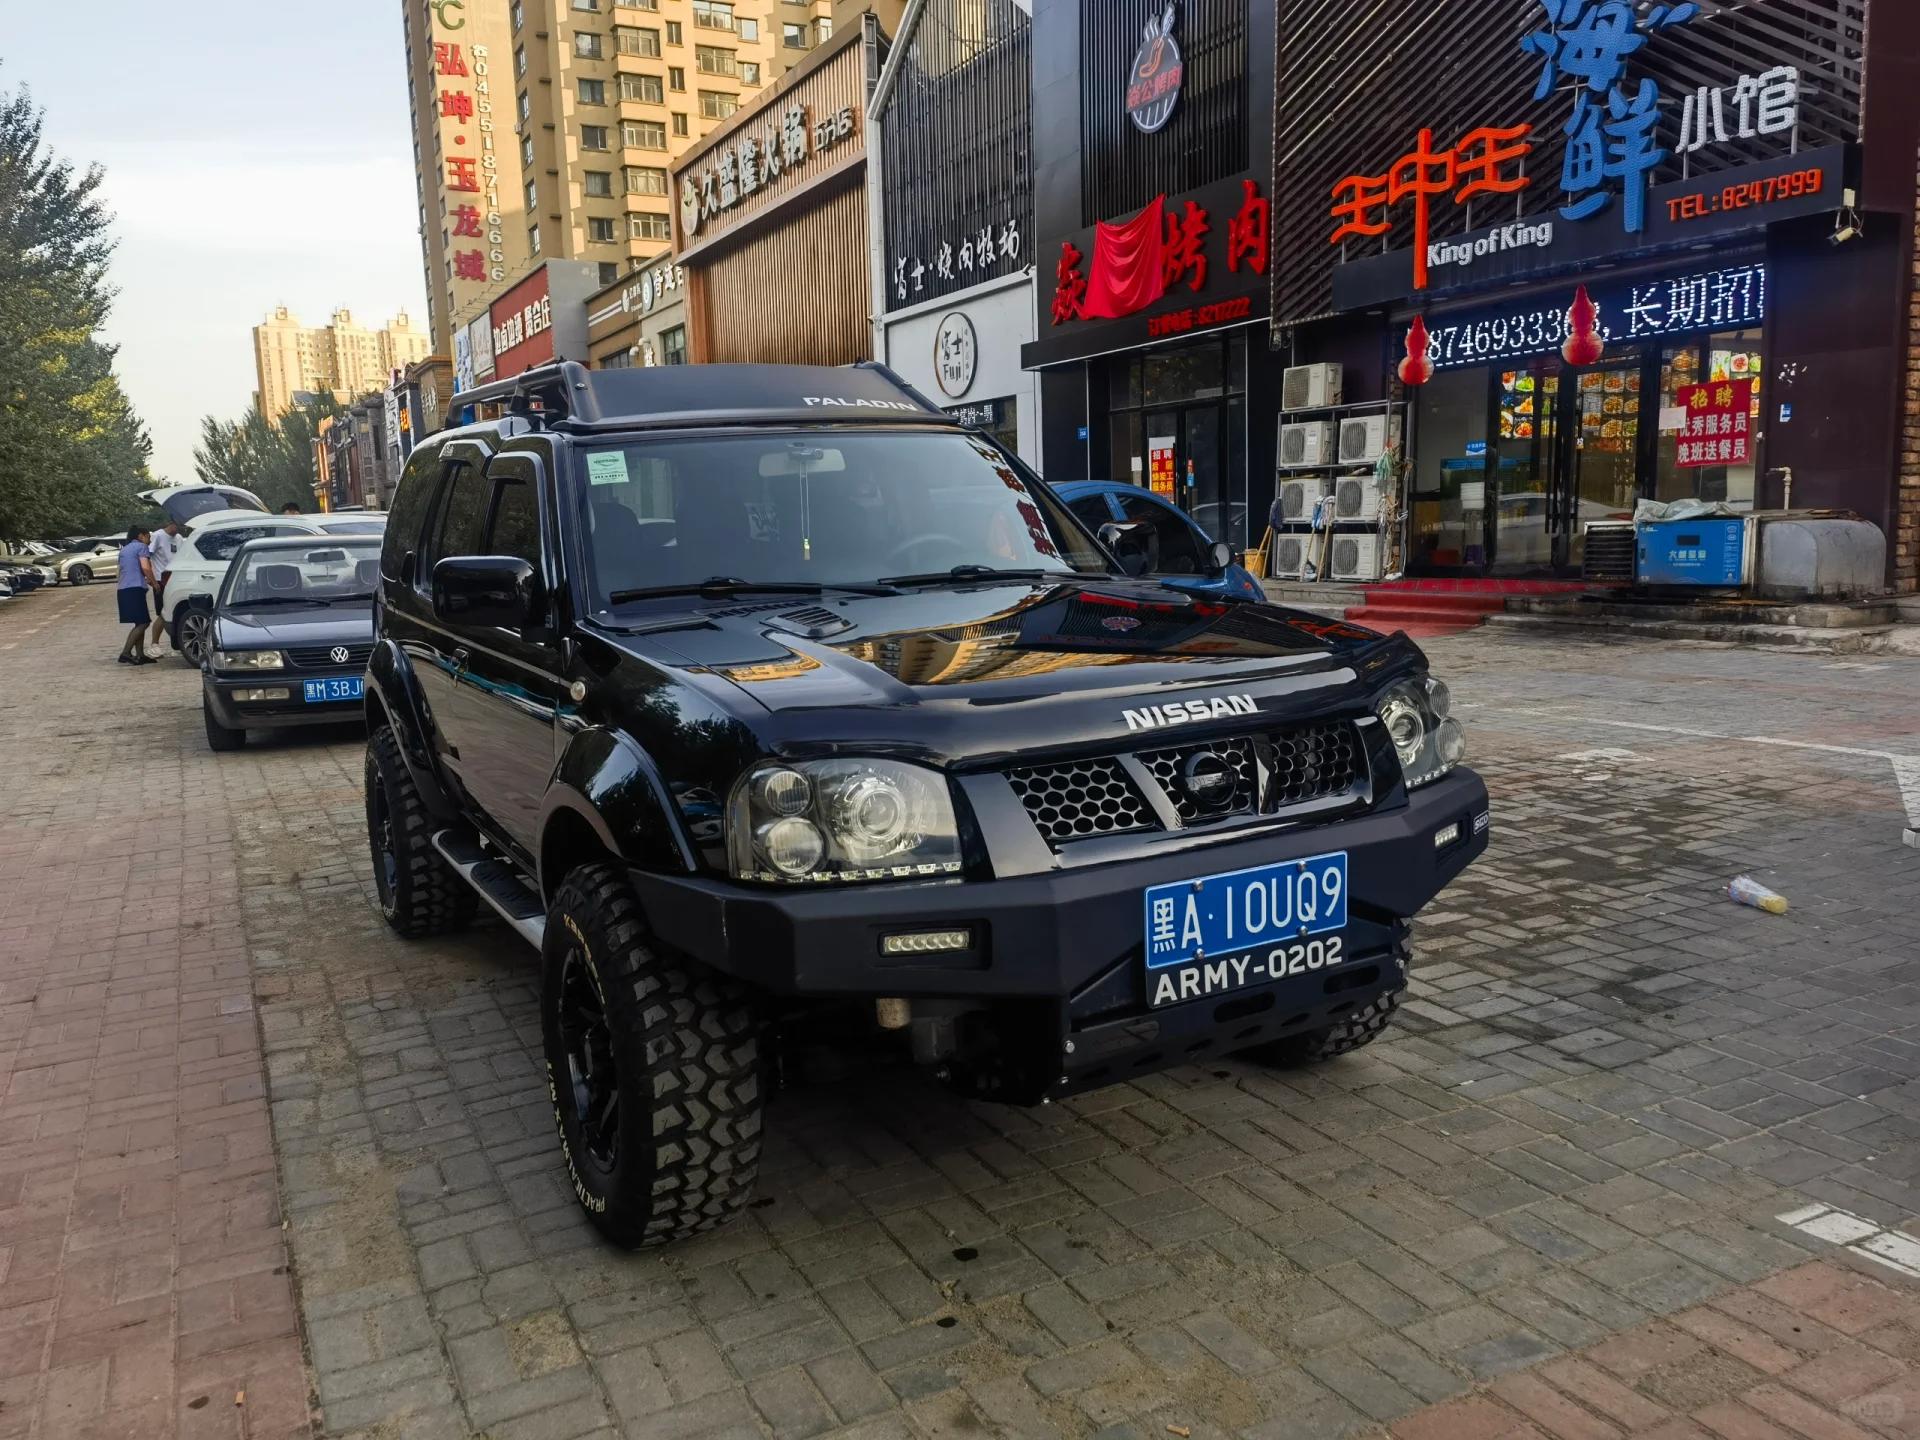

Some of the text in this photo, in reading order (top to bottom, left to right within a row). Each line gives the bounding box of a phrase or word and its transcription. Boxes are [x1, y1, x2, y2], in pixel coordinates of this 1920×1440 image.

[1519, 0, 1700, 233] 海鲜
[1675, 65, 1799, 154] 小馆
[700, 103, 808, 220] 久盛隆火锅
[1330, 123, 1532, 289] 王中王
[1666, 168, 1822, 222] TEL:8247999
[1050, 179, 1271, 327] 焱烤肉
[1427, 222, 1552, 268] King of King
[942, 361, 962, 382] Fuji
[1690, 384, 1734, 410] 招聘
[802, 395, 920, 412] PALADIN
[1677, 438, 1747, 464] 晚班送餐员
[306, 680, 364, 699] 黑M·3BJ
[1121, 693, 1259, 731] NISSAN
[1153, 866, 1343, 954] 黑A·10UQ9
[1153, 936, 1343, 1006] ARMY-0202
